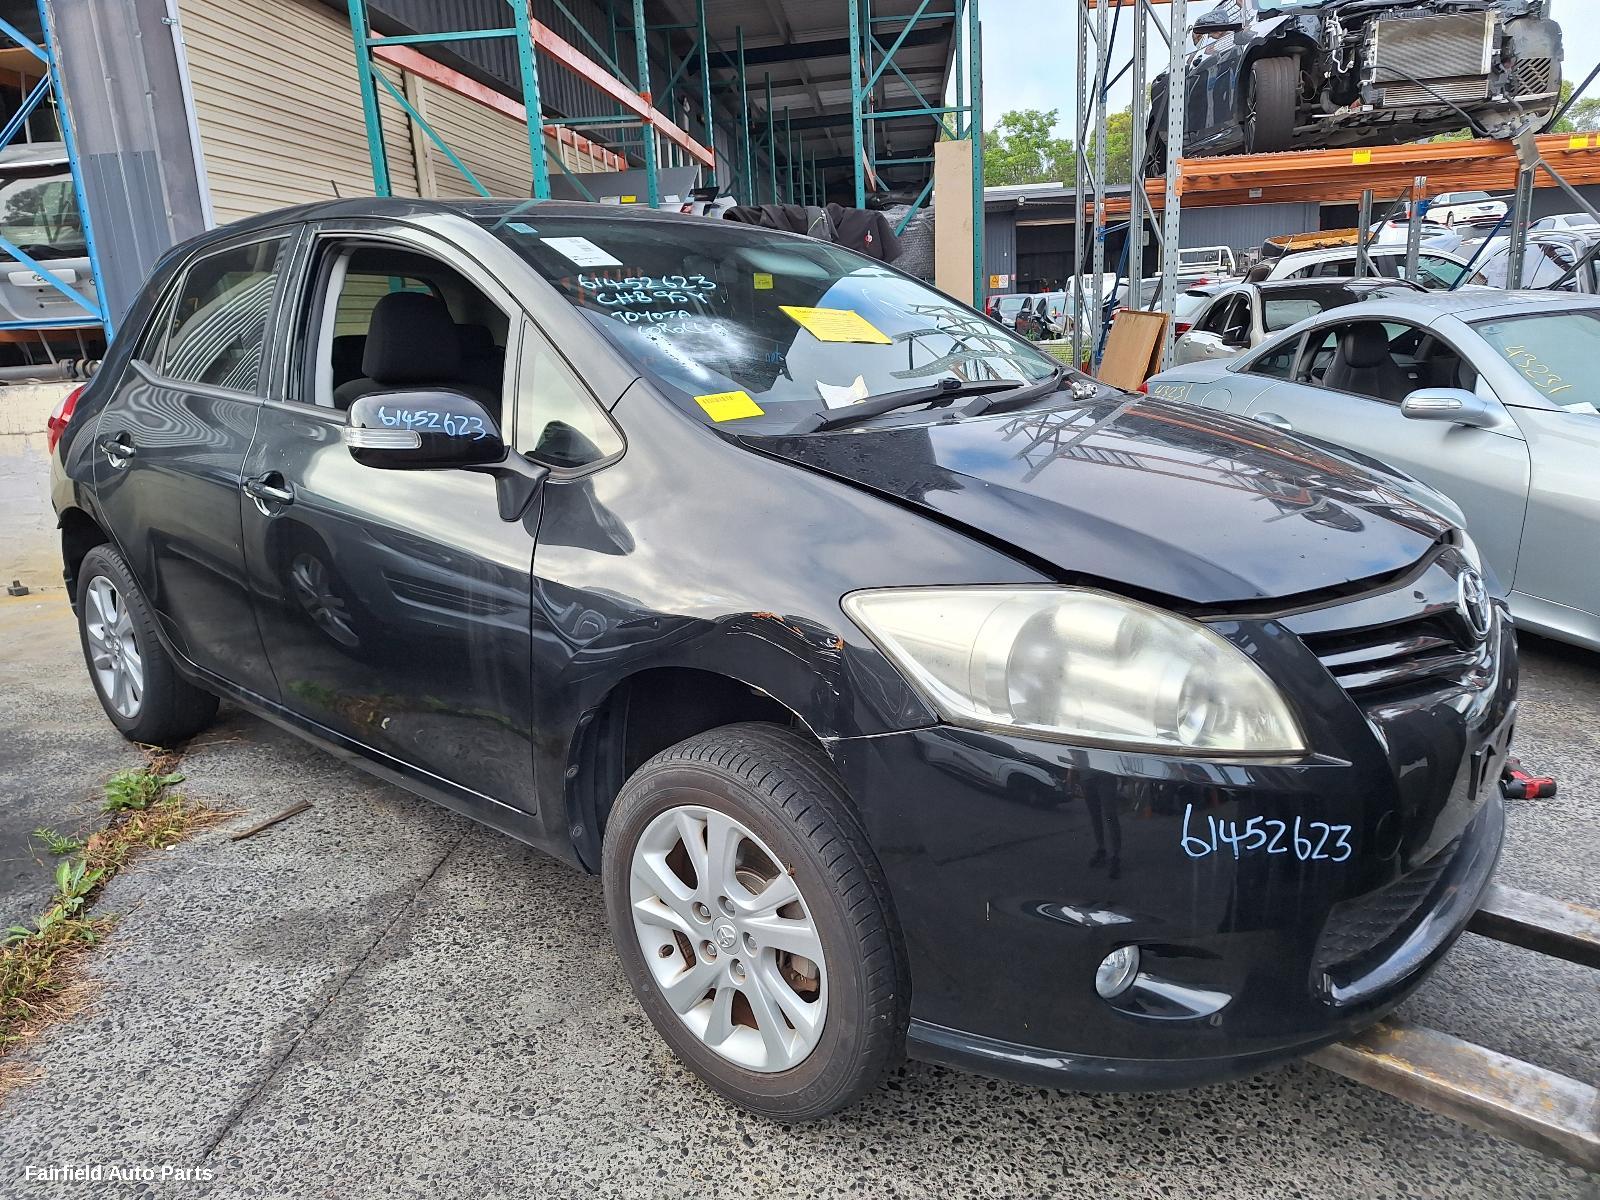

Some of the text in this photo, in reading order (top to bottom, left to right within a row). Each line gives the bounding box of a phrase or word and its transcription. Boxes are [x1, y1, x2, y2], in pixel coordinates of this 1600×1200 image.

[578, 274, 717, 290] 61452623
[611, 309, 692, 324] TOYOTA
[1504, 345, 1575, 394] 43231
[1153, 383, 1194, 401] 43231
[377, 406, 487, 440] 61452623
[1180, 802, 1353, 862] 61452623
